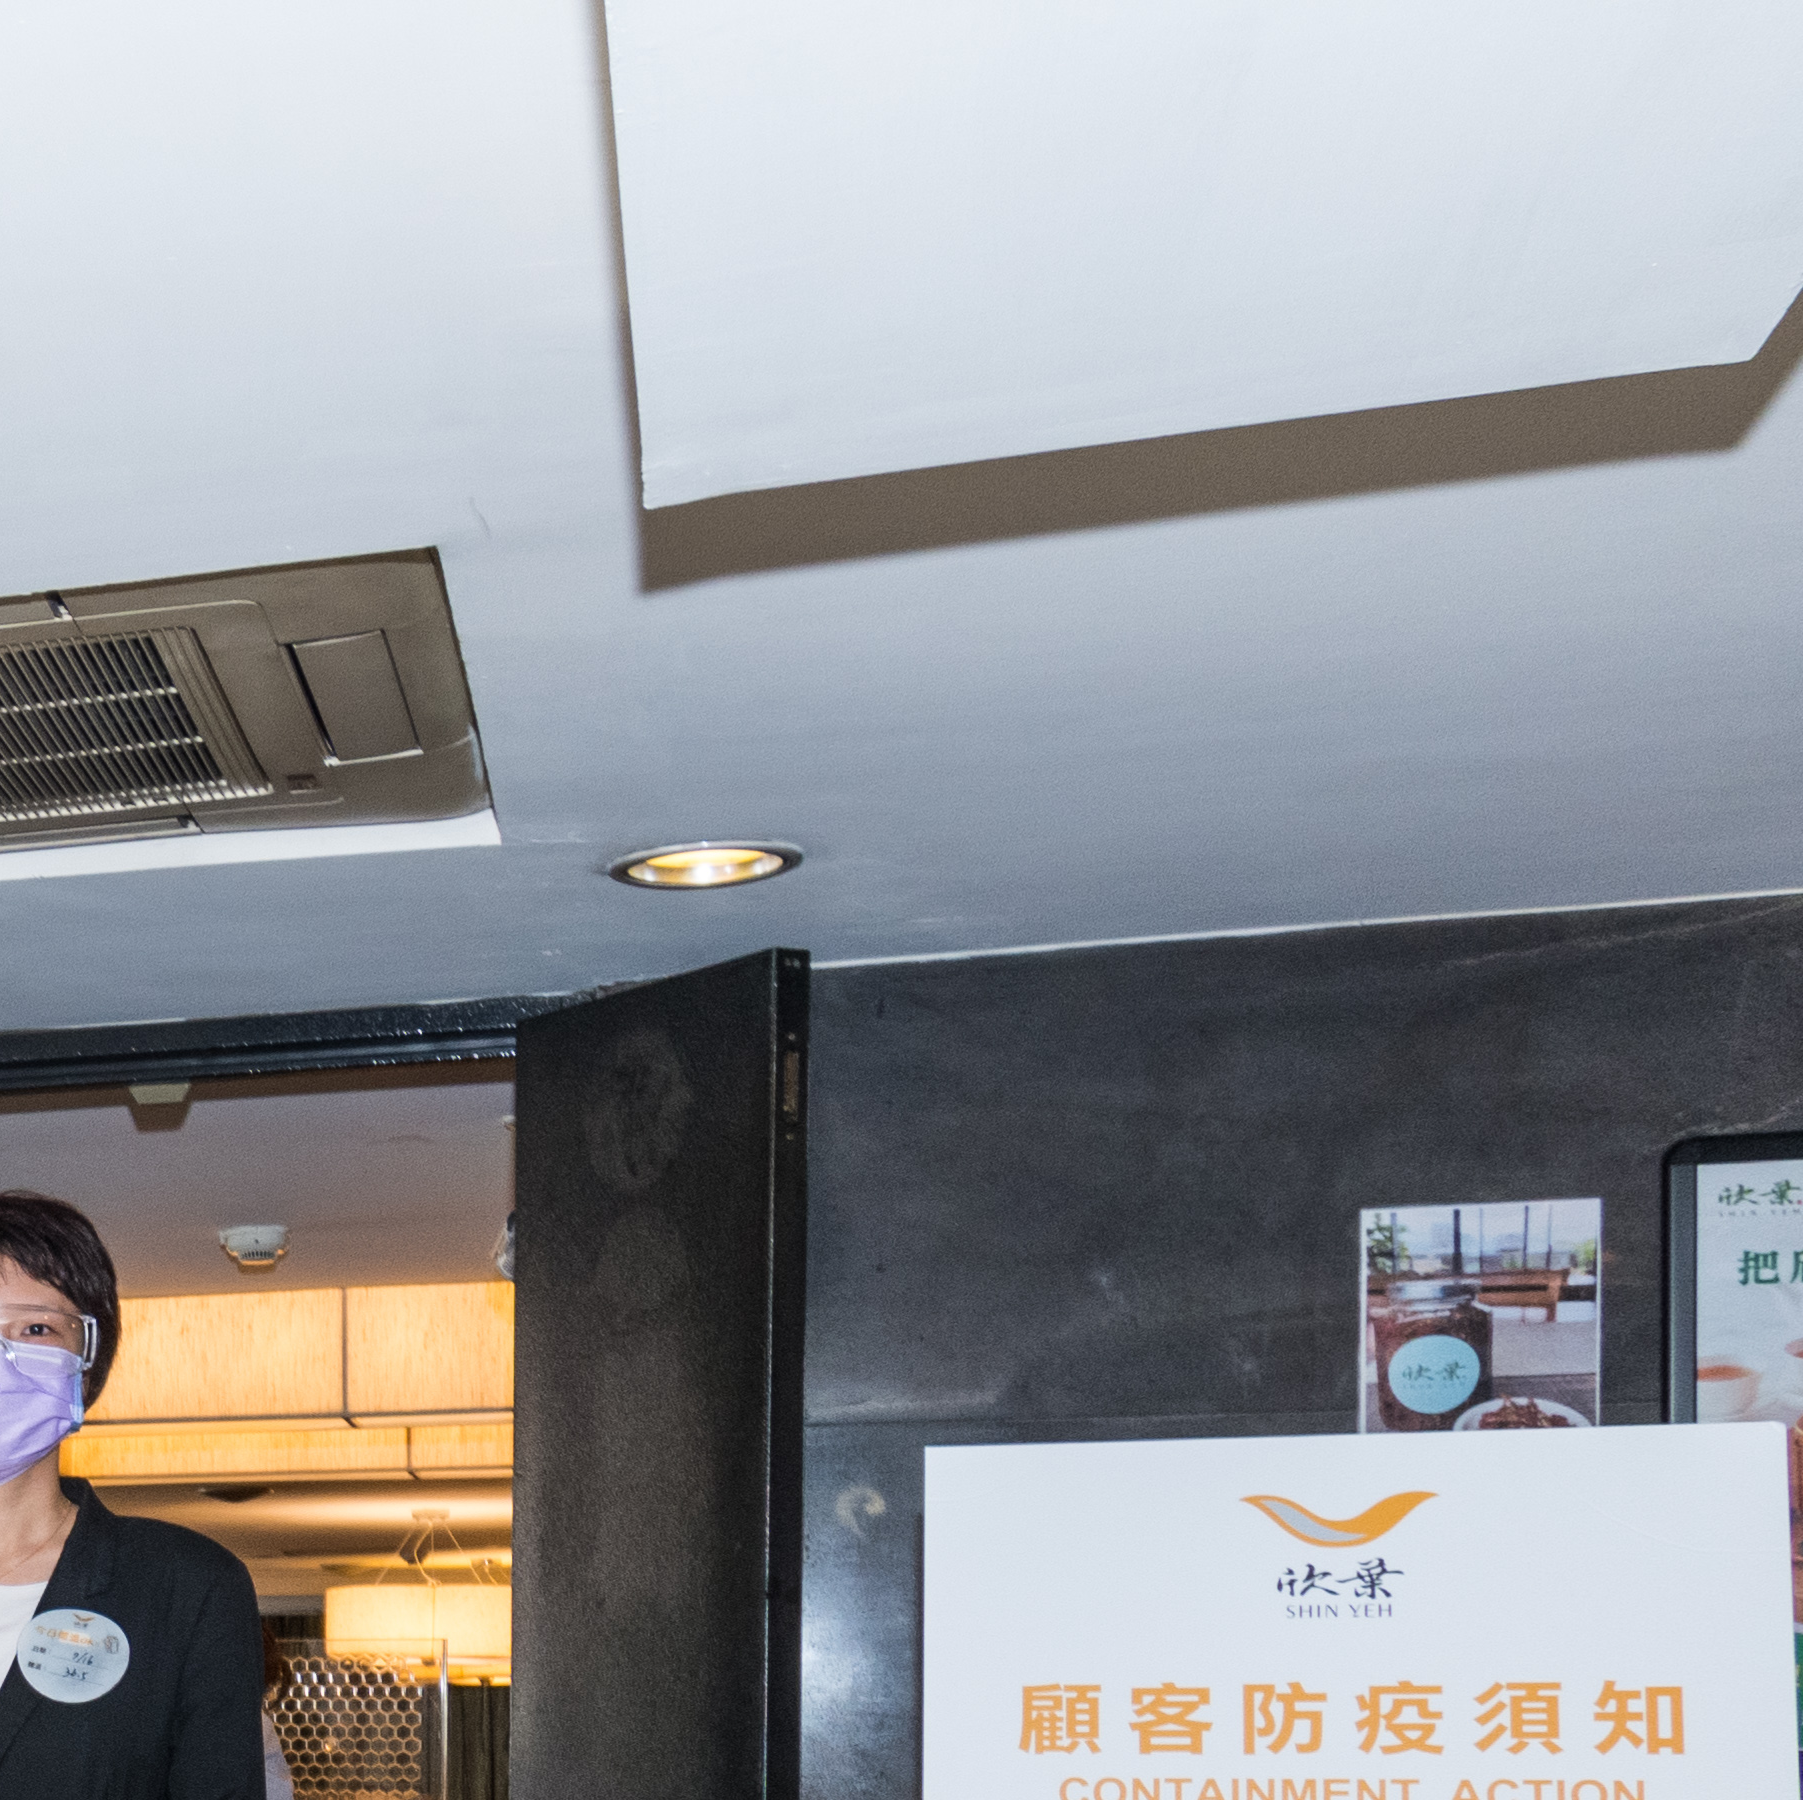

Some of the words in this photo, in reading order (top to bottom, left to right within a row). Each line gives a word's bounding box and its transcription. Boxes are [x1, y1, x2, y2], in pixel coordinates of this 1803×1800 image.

[1276, 1557, 1405, 1599] 欣葉
[1286, 1604, 1338, 1618] SHIN
[1349, 1603, 1392, 1618] YEH
[1018, 1680, 1686, 1756] 顧客防疫須知
